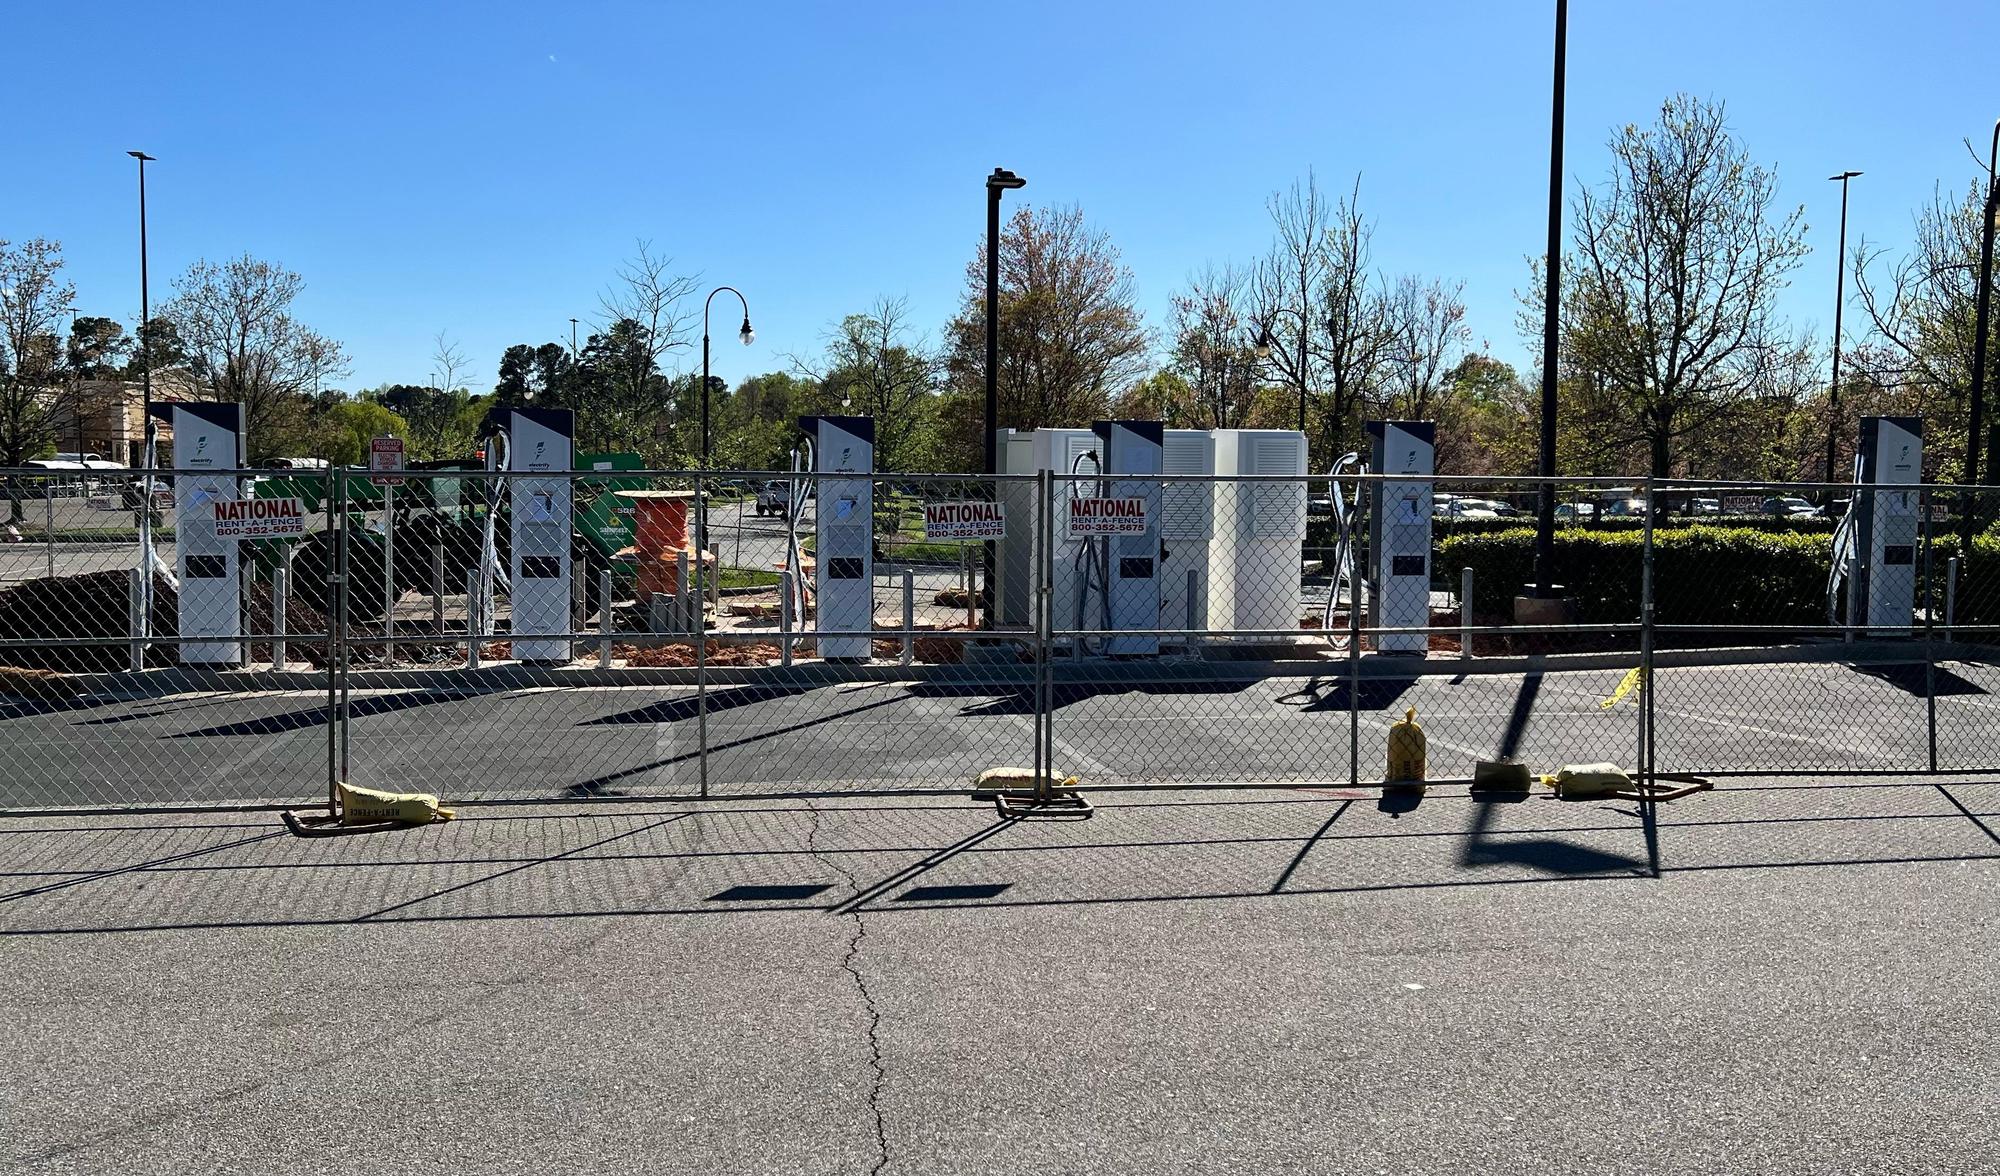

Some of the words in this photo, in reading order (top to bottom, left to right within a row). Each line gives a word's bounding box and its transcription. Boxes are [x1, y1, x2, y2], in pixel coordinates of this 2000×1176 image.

[215, 500, 302, 520] NATIONAL
[927, 504, 1002, 523] NATIONAL
[1071, 499, 1144, 517] NATIONAL
[216, 518, 302, 528] RENT-A-FENCE
[928, 521, 1003, 530] RENT-A-FENCE
[217, 525, 303, 536] 800-352-5675
[928, 528, 1003, 538] 800-352-5675
